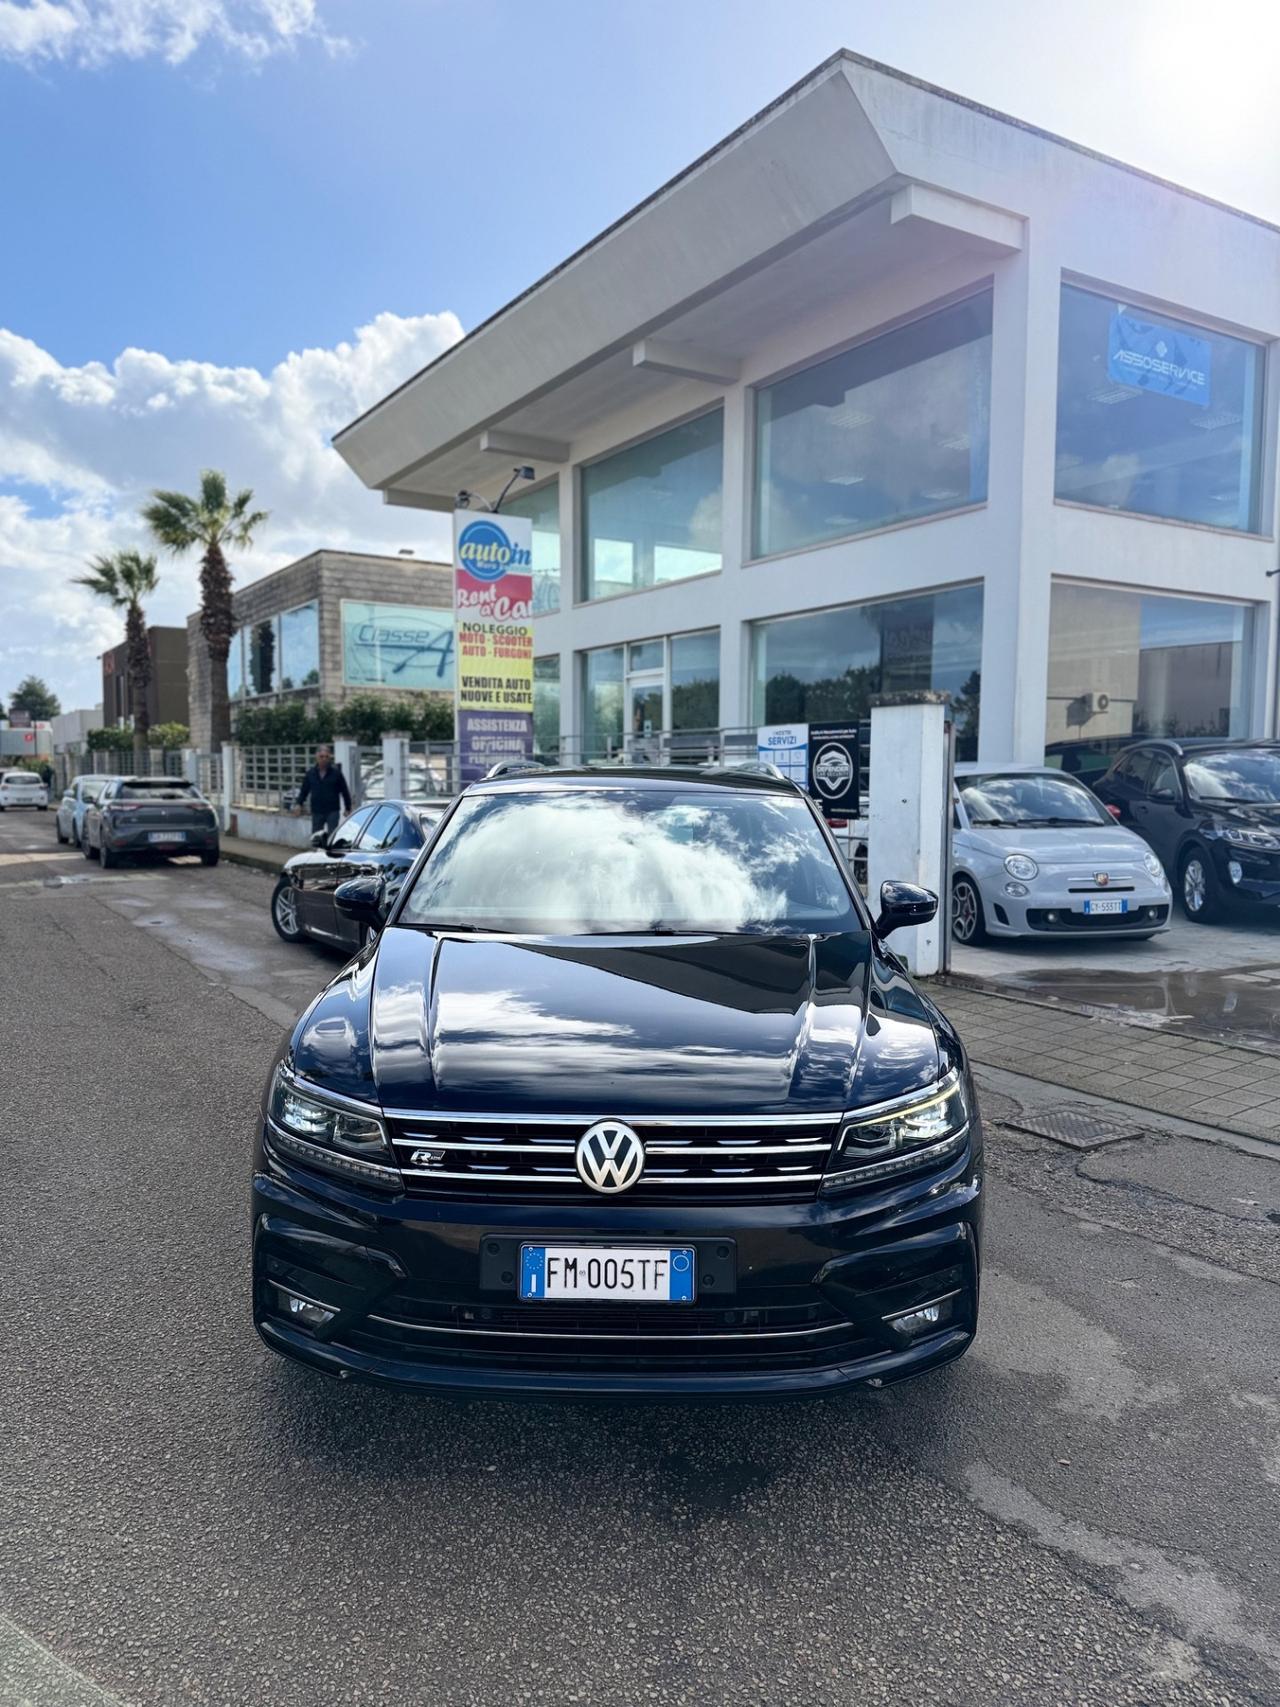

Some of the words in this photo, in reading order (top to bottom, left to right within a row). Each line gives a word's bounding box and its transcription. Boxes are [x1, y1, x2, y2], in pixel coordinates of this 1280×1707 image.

[1113, 349, 1206, 386] ASSOSERVICE
[457, 584, 497, 609] Rent
[358, 624, 430, 644] Classe
[462, 621, 528, 637] NOLEGGIO
[459, 631, 486, 645] MOTO
[492, 633, 533, 648] SCOOTER
[462, 645, 487, 657] AUTO
[493, 647, 532, 660] FURGONI
[462, 675, 504, 690] VENDITA
[505, 678, 531, 691] AUTO
[460, 690, 493, 703] NUOVE
[495, 691, 501, 703] E
[503, 692, 532, 705] USATE
[467, 718, 528, 733] ASSISTENZA
[768, 736, 797, 746] SERVIZI
[546, 1257, 668, 1290] FM005TF
